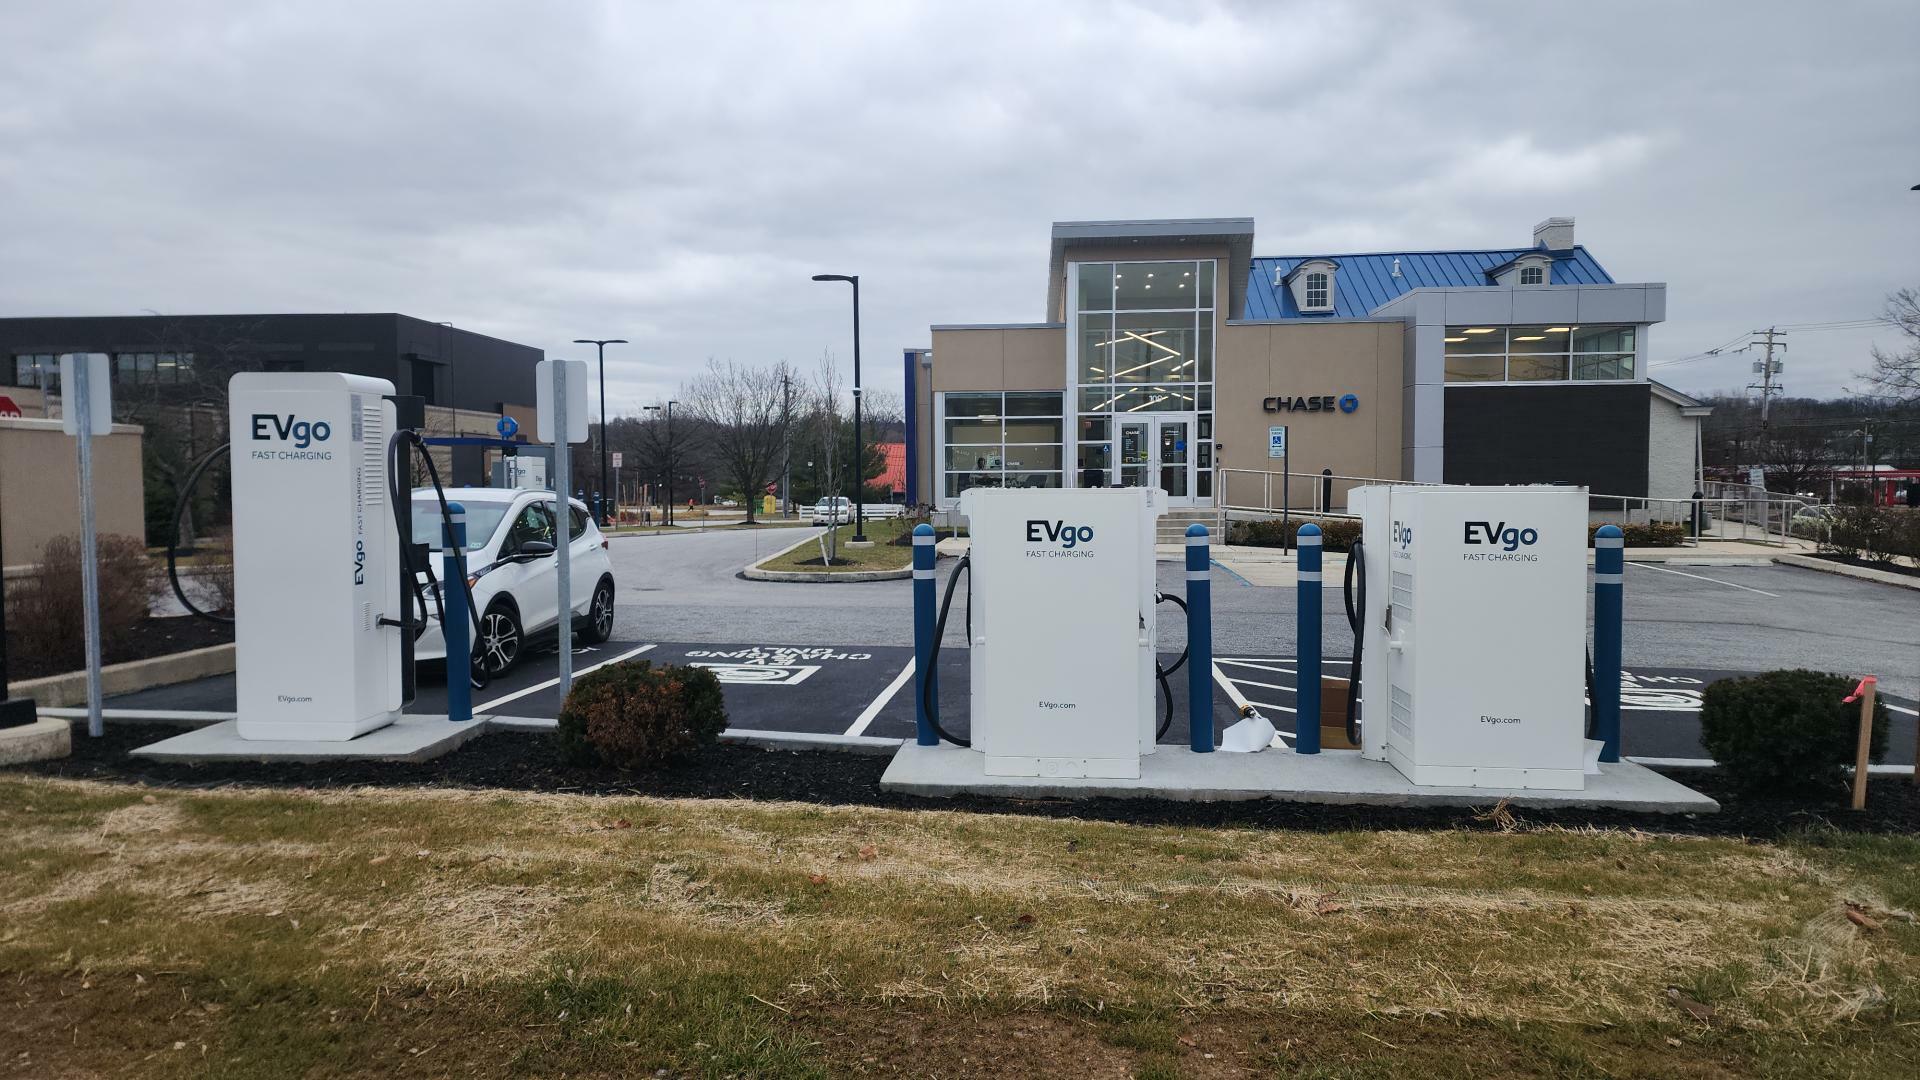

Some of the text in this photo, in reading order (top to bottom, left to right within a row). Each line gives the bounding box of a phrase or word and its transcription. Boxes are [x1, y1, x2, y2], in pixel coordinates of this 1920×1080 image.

[1263, 396, 1336, 413] CHASE
[252, 414, 331, 449] EVgo
[252, 451, 332, 461] FAST CHARGING
[1026, 520, 1094, 549] EVgo
[1393, 520, 1412, 550] EVgo
[1464, 521, 1538, 552] EVgo
[1026, 550, 1094, 558] FAST CHARGING
[1463, 553, 1538, 562] FAST CHARGING
[354, 540, 365, 586] EVgo
[685, 650, 872, 660] CHARGING
[277, 695, 313, 704] EVgo.com
[1039, 701, 1076, 709] EVgo.com
[1480, 715, 1521, 724] EVgo.com
